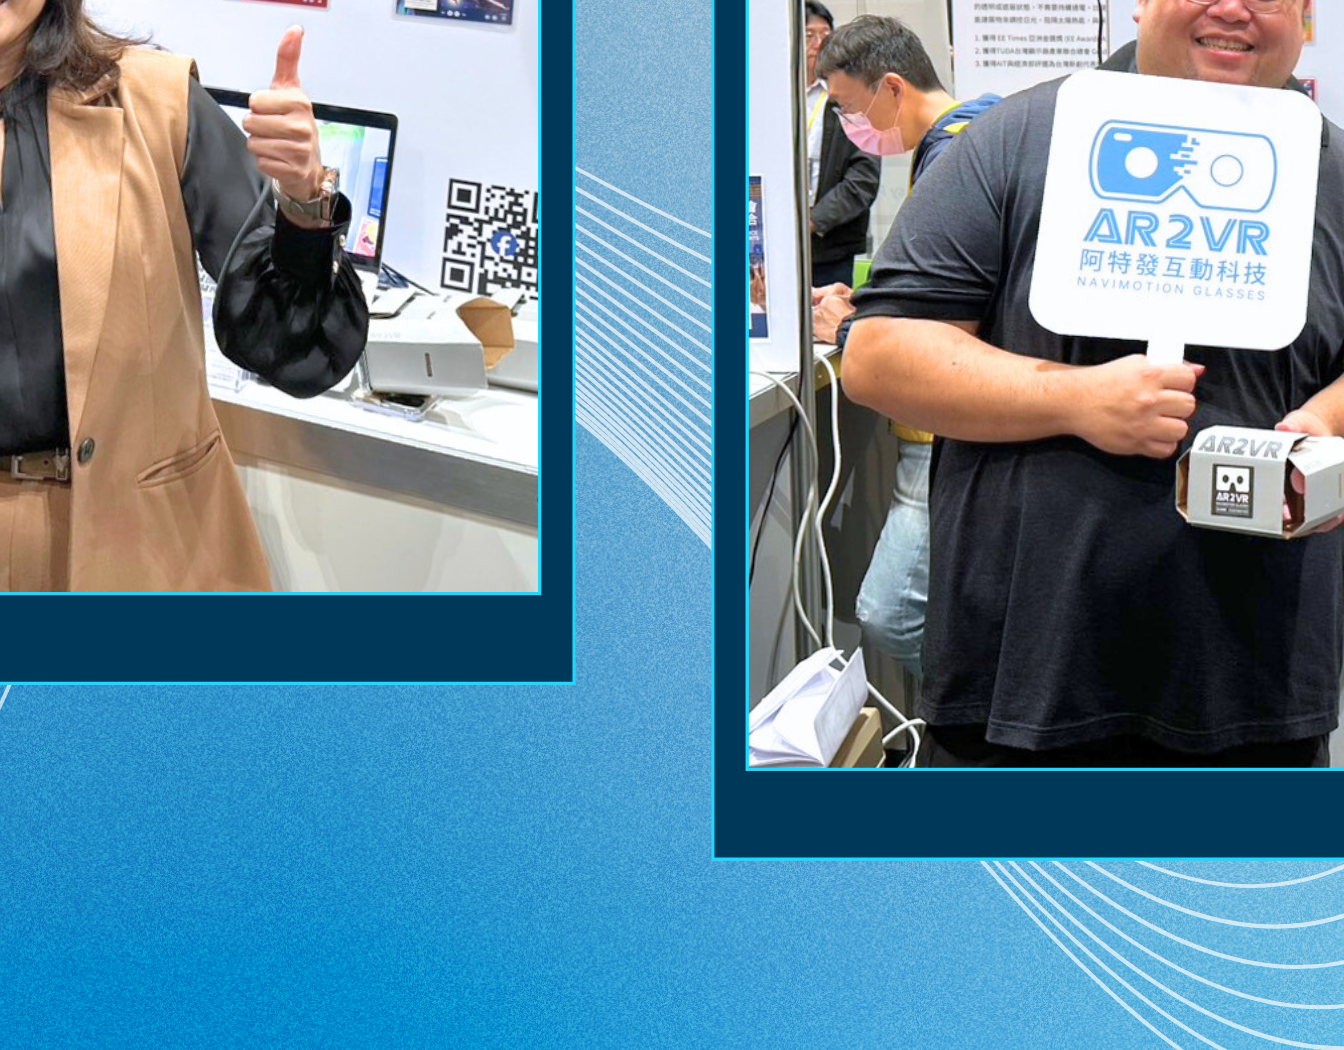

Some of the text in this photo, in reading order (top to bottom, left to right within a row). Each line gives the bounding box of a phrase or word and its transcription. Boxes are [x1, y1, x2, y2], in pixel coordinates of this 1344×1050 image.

[1082, 207, 1271, 256] AR2VR
[1078, 247, 1268, 286] 阿特發互動科技
[1076, 276, 1266, 301] NAVIMOTION GLASSES
[1198, 434, 1283, 459] AR2VR
[1216, 491, 1249, 504] AR2VR
